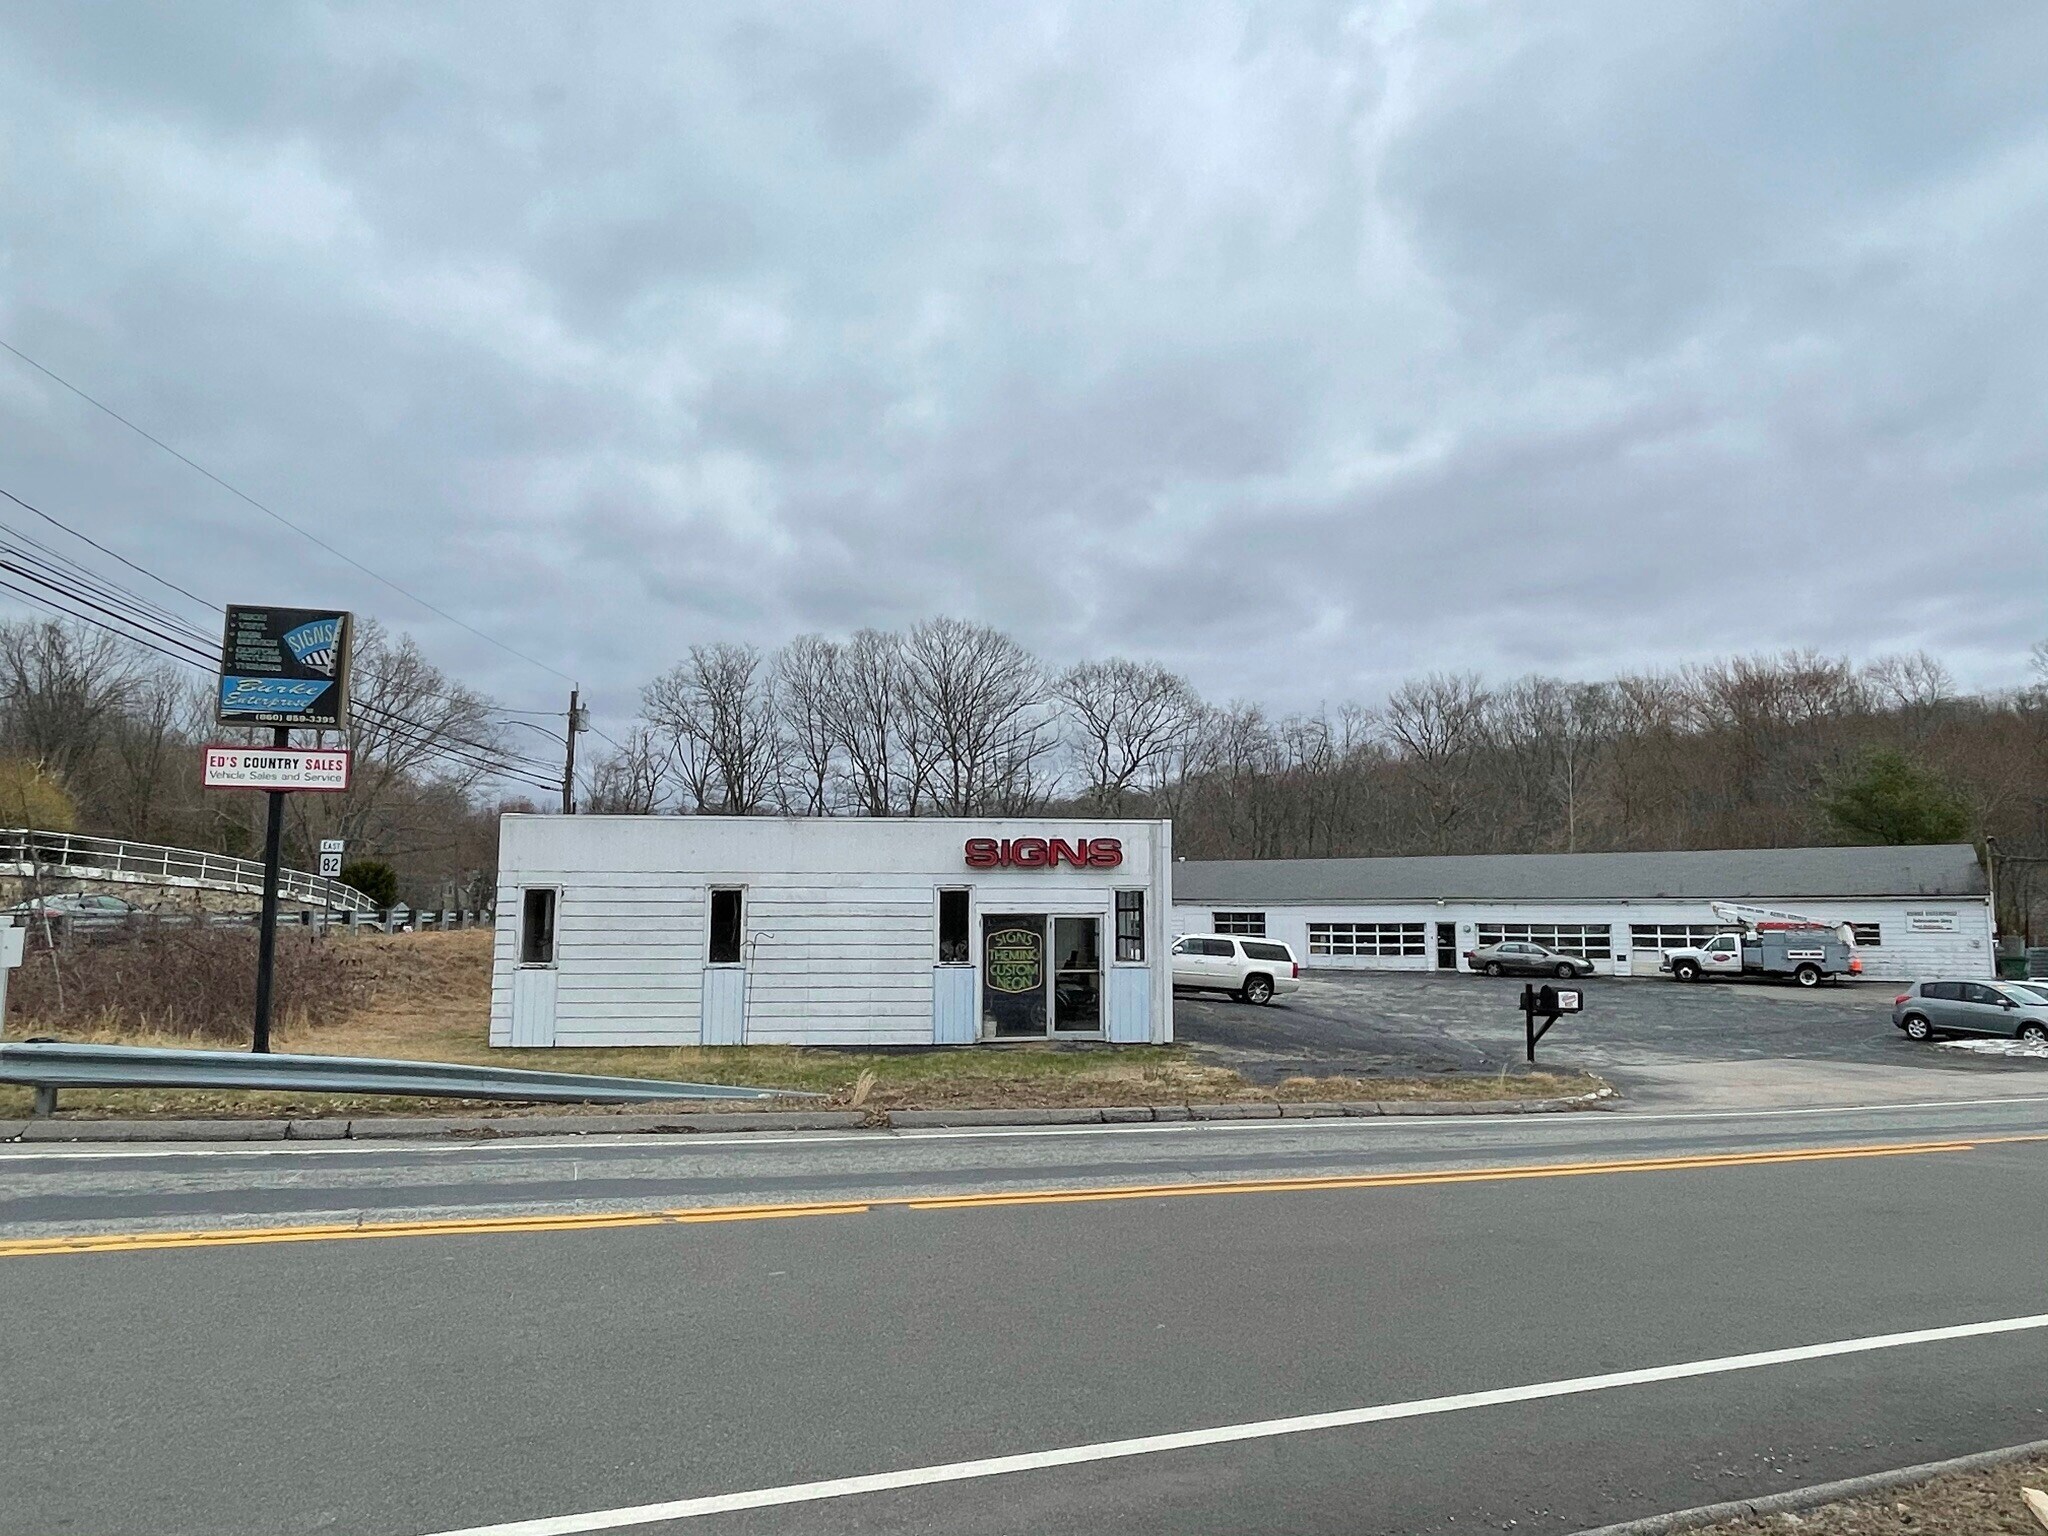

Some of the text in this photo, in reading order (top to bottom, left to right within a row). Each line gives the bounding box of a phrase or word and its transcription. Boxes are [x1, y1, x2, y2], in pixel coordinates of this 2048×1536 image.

[288, 624, 333, 653] SIGNS
[236, 679, 318, 696] Burke
[255, 713, 283, 722] (860)
[210, 755, 343, 771] ED'S COUNTRY SALES
[209, 770, 342, 783] Vehicle Sales and Service
[323, 841, 341, 850] EAST
[964, 837, 1123, 869] SIGNS
[323, 858, 339, 872] 82
[994, 931, 1033, 946] SIGNS
[988, 948, 1040, 961] THEMING
[989, 963, 1039, 976] CUSTOM
[996, 975, 1033, 990] NEON
